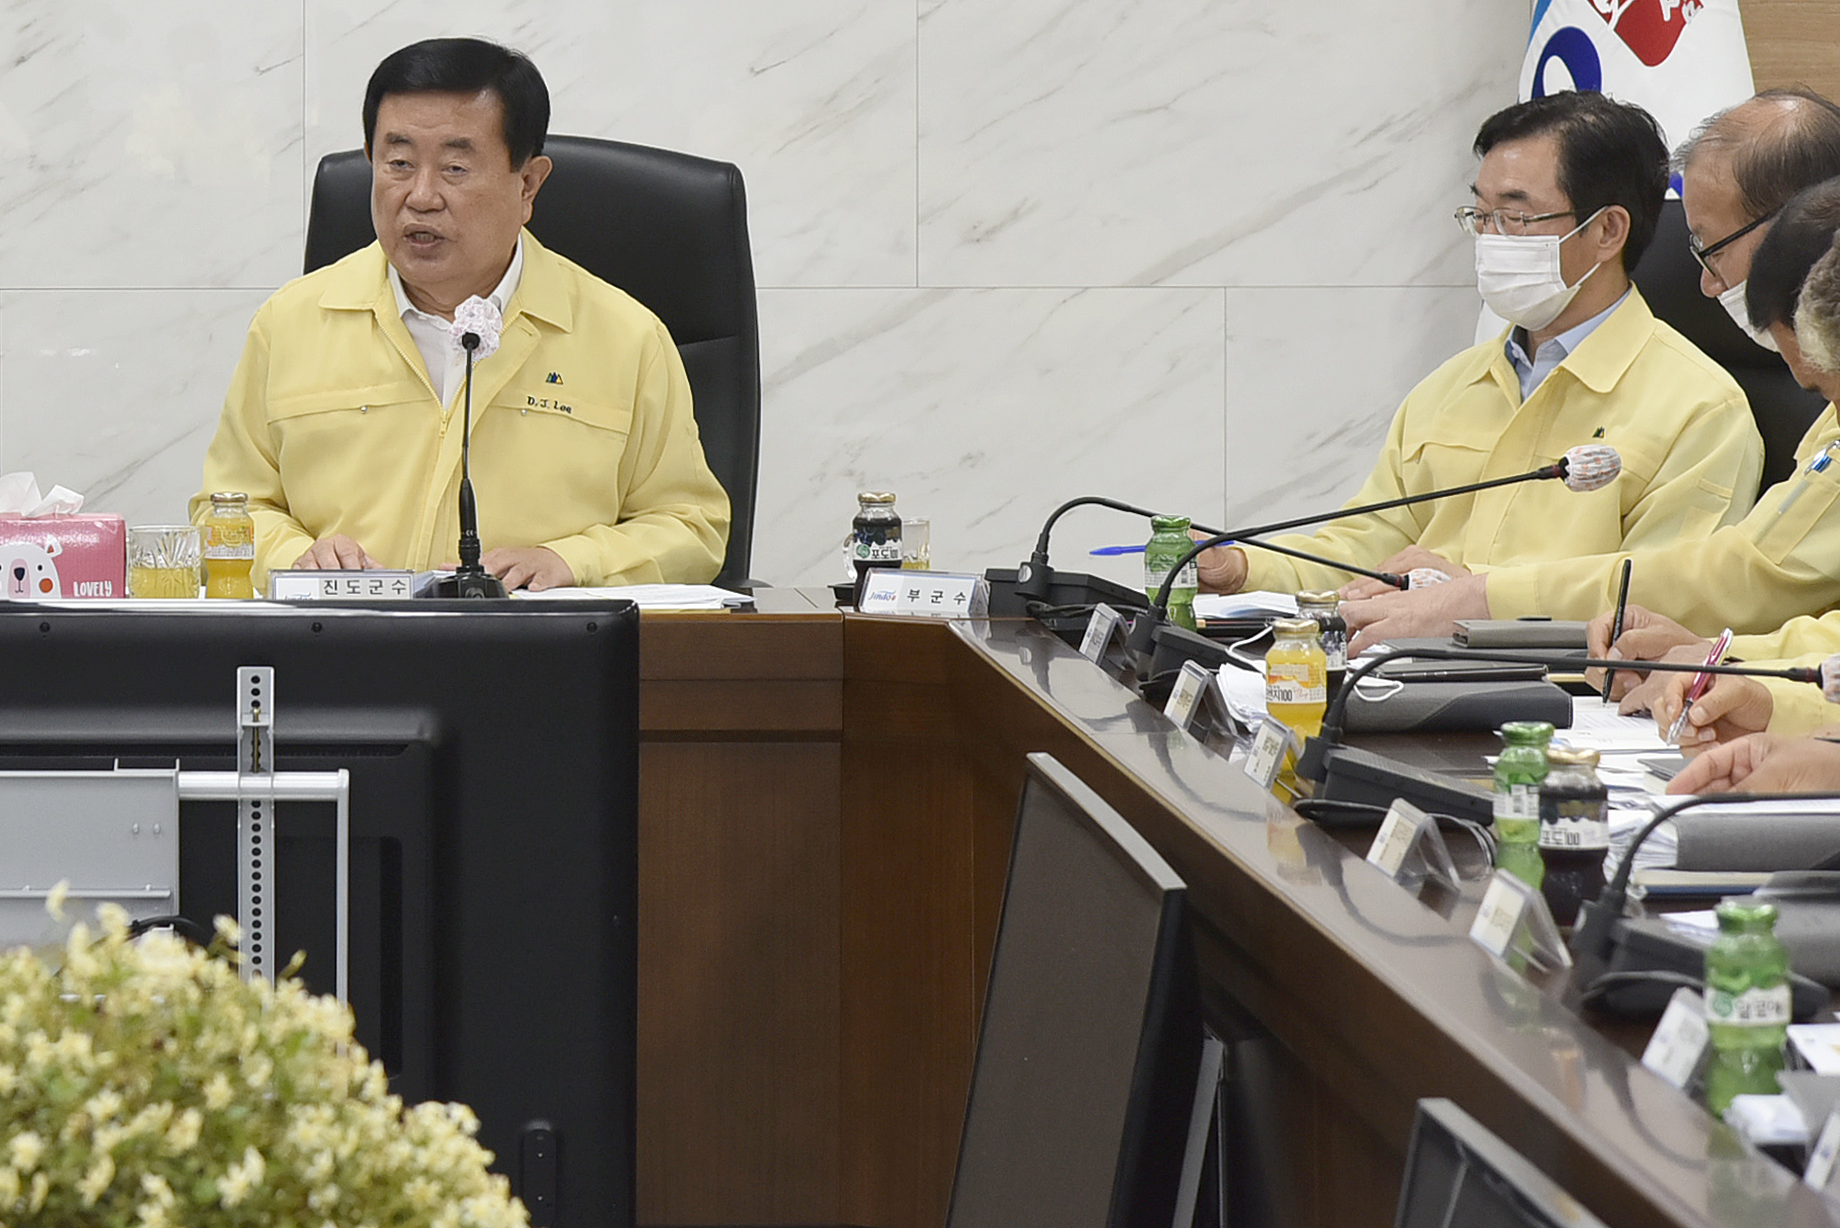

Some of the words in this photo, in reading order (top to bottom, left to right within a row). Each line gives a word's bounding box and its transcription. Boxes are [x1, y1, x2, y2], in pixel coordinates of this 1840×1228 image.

[73, 580, 113, 597] LOVELY
[323, 580, 407, 595] 진도군수
[907, 589, 966, 605] 부군수
